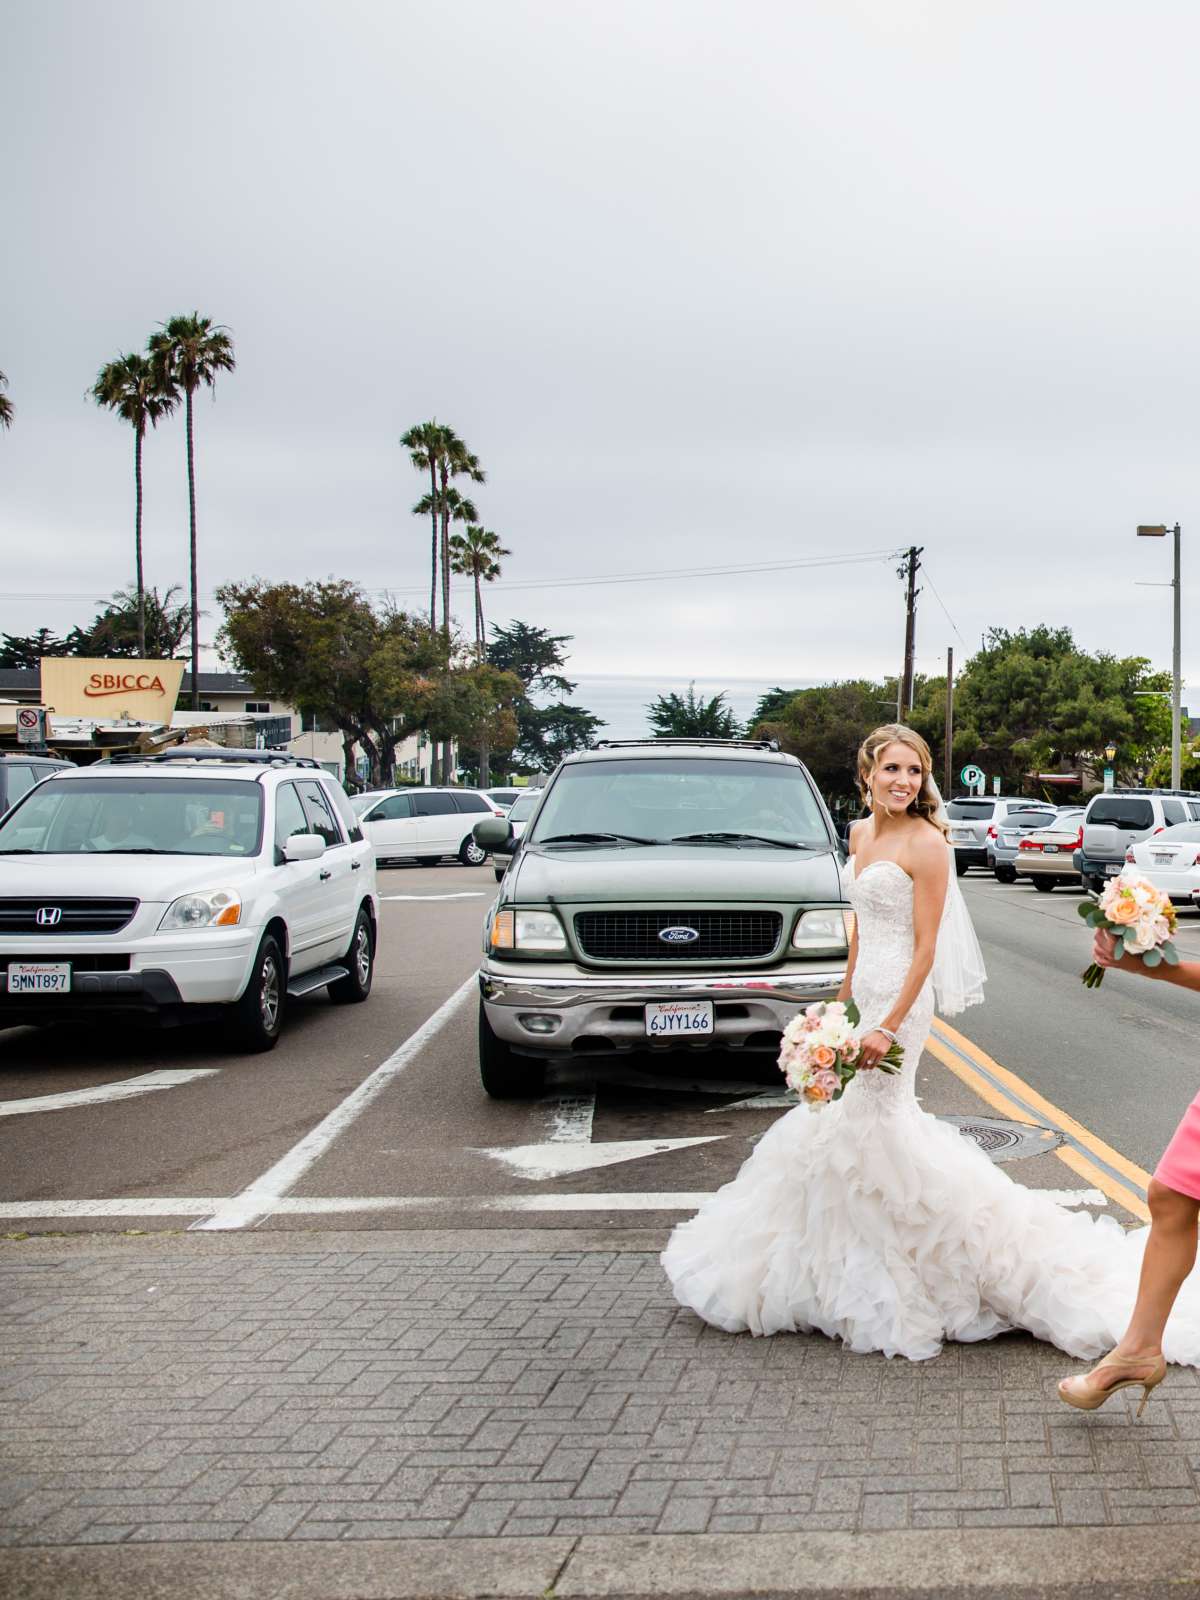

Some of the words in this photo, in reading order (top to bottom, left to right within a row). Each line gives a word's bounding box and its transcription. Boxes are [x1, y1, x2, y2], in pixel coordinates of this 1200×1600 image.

[88, 674, 165, 693] SBICCA
[968, 770, 977, 781] P
[668, 930, 690, 940] Ford
[22, 965, 56, 974] California
[12, 974, 66, 989] 5MNT897
[658, 1004, 697, 1014] California
[650, 1013, 709, 1031] 6JYY166
